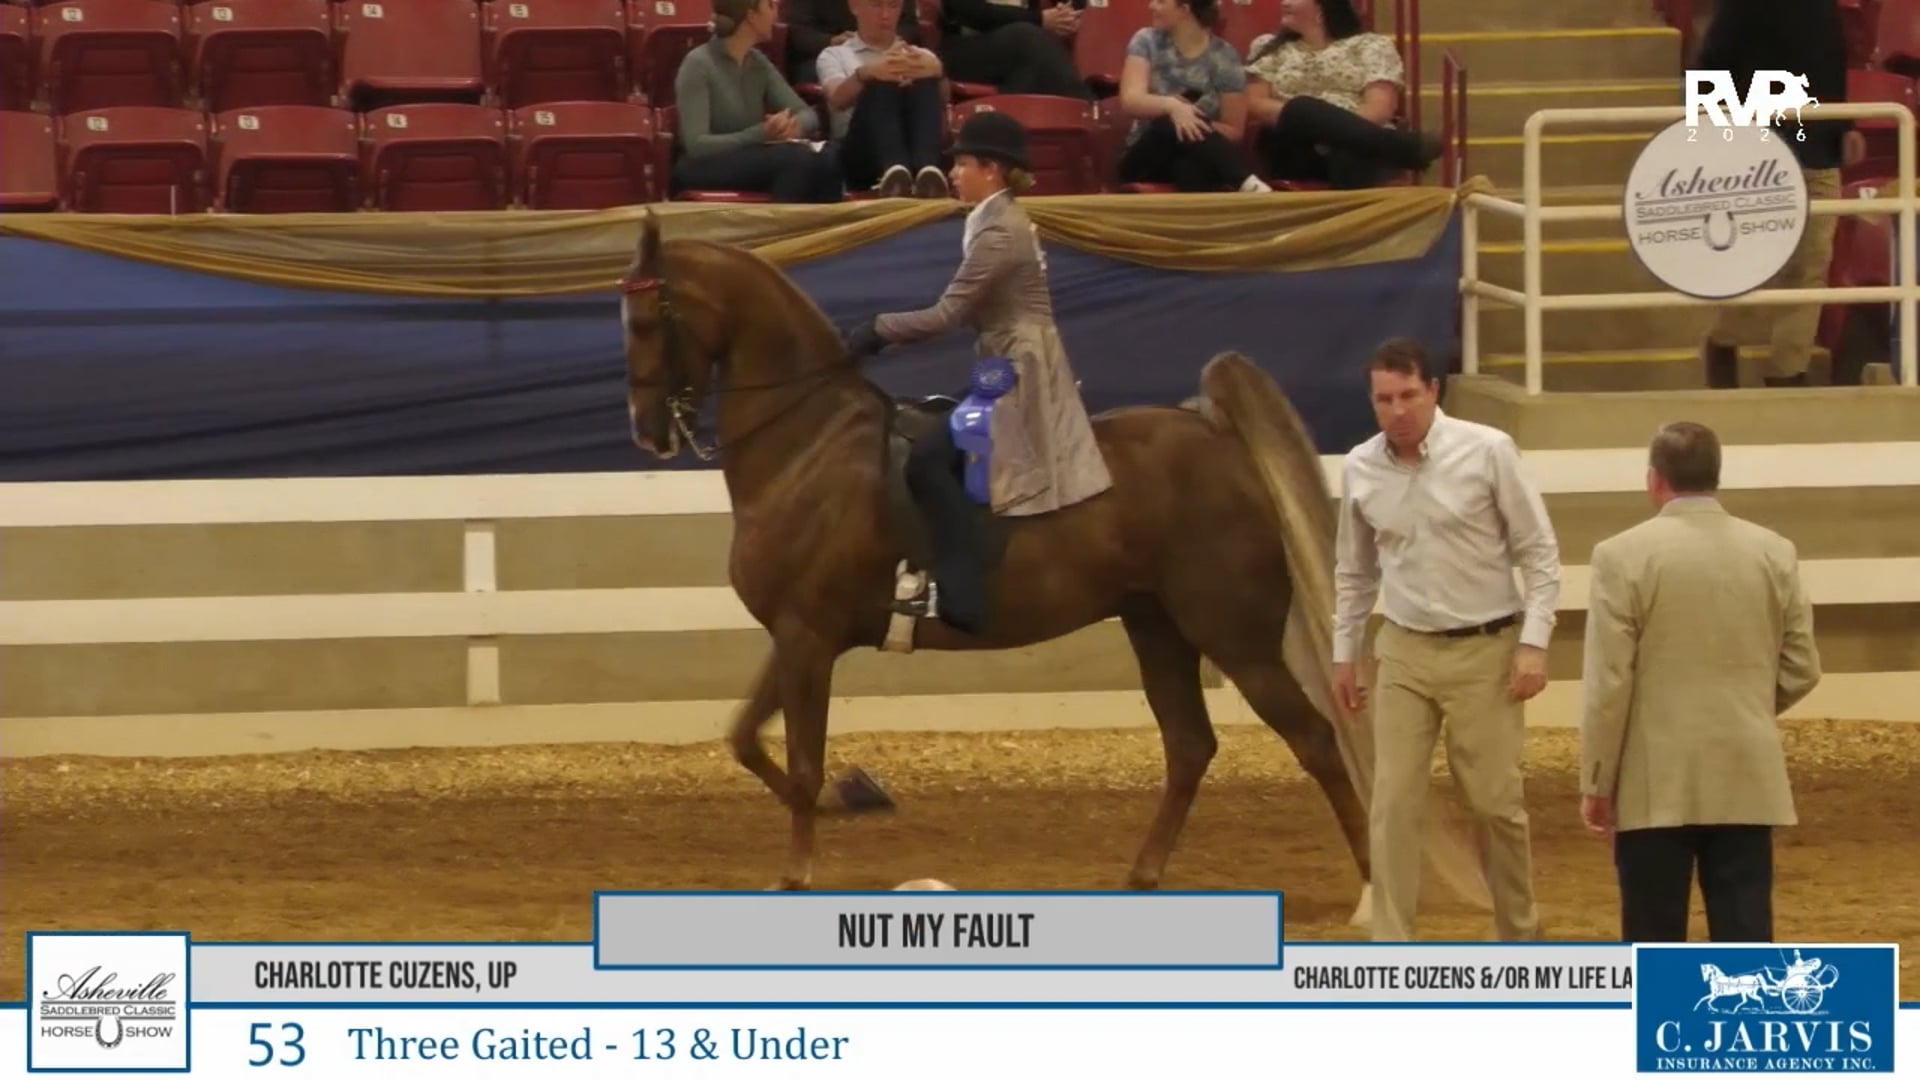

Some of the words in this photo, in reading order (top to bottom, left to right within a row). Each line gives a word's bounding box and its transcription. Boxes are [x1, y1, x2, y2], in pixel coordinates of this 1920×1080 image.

[1635, 159, 1789, 199] Asheville
[1636, 199, 1732, 219] SADDLEBRED
[1734, 193, 1798, 209] CLASSIC
[1638, 226, 1701, 245] HORSE
[1740, 218, 1797, 236] SHOW
